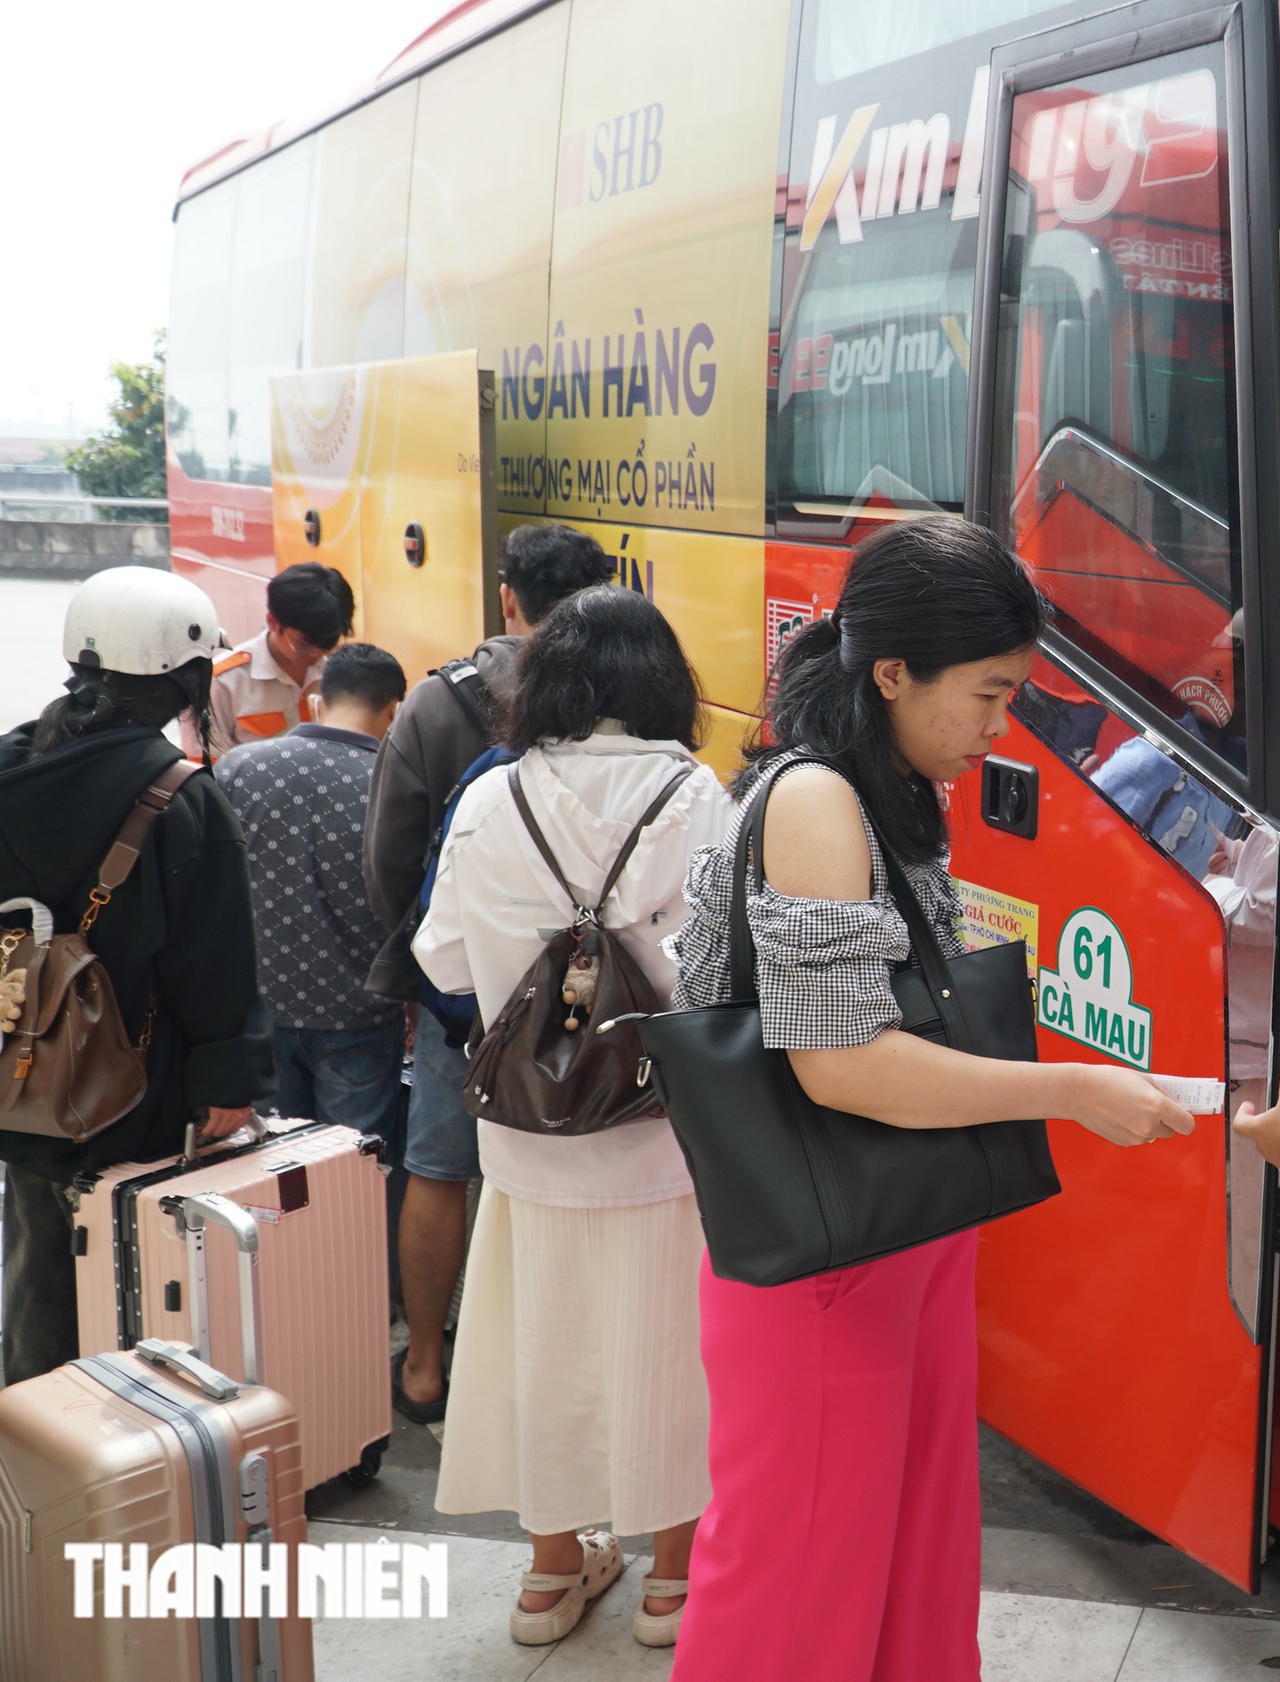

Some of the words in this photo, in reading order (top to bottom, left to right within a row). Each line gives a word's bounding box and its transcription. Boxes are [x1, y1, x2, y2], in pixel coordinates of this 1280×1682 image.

[589, 102, 664, 202] SHB
[502, 320, 591, 421] NGÂN
[603, 308, 716, 417] HÀNG
[501, 454, 572, 502] THƯƠNG
[578, 459, 610, 517] MẠI
[617, 438, 648, 507] CỔ
[655, 442, 714, 512] PHẦN
[965, 904, 985, 922] GIÁ
[988, 912, 1022, 935] CƯỚC
[972, 889, 1005, 909] PHƯƠNG
[1007, 902, 1035, 919] TRANG
[1073, 926, 1112, 989] 61
[1042, 981, 1074, 1032] CÀ
[1085, 1001, 1146, 1062] MAU
